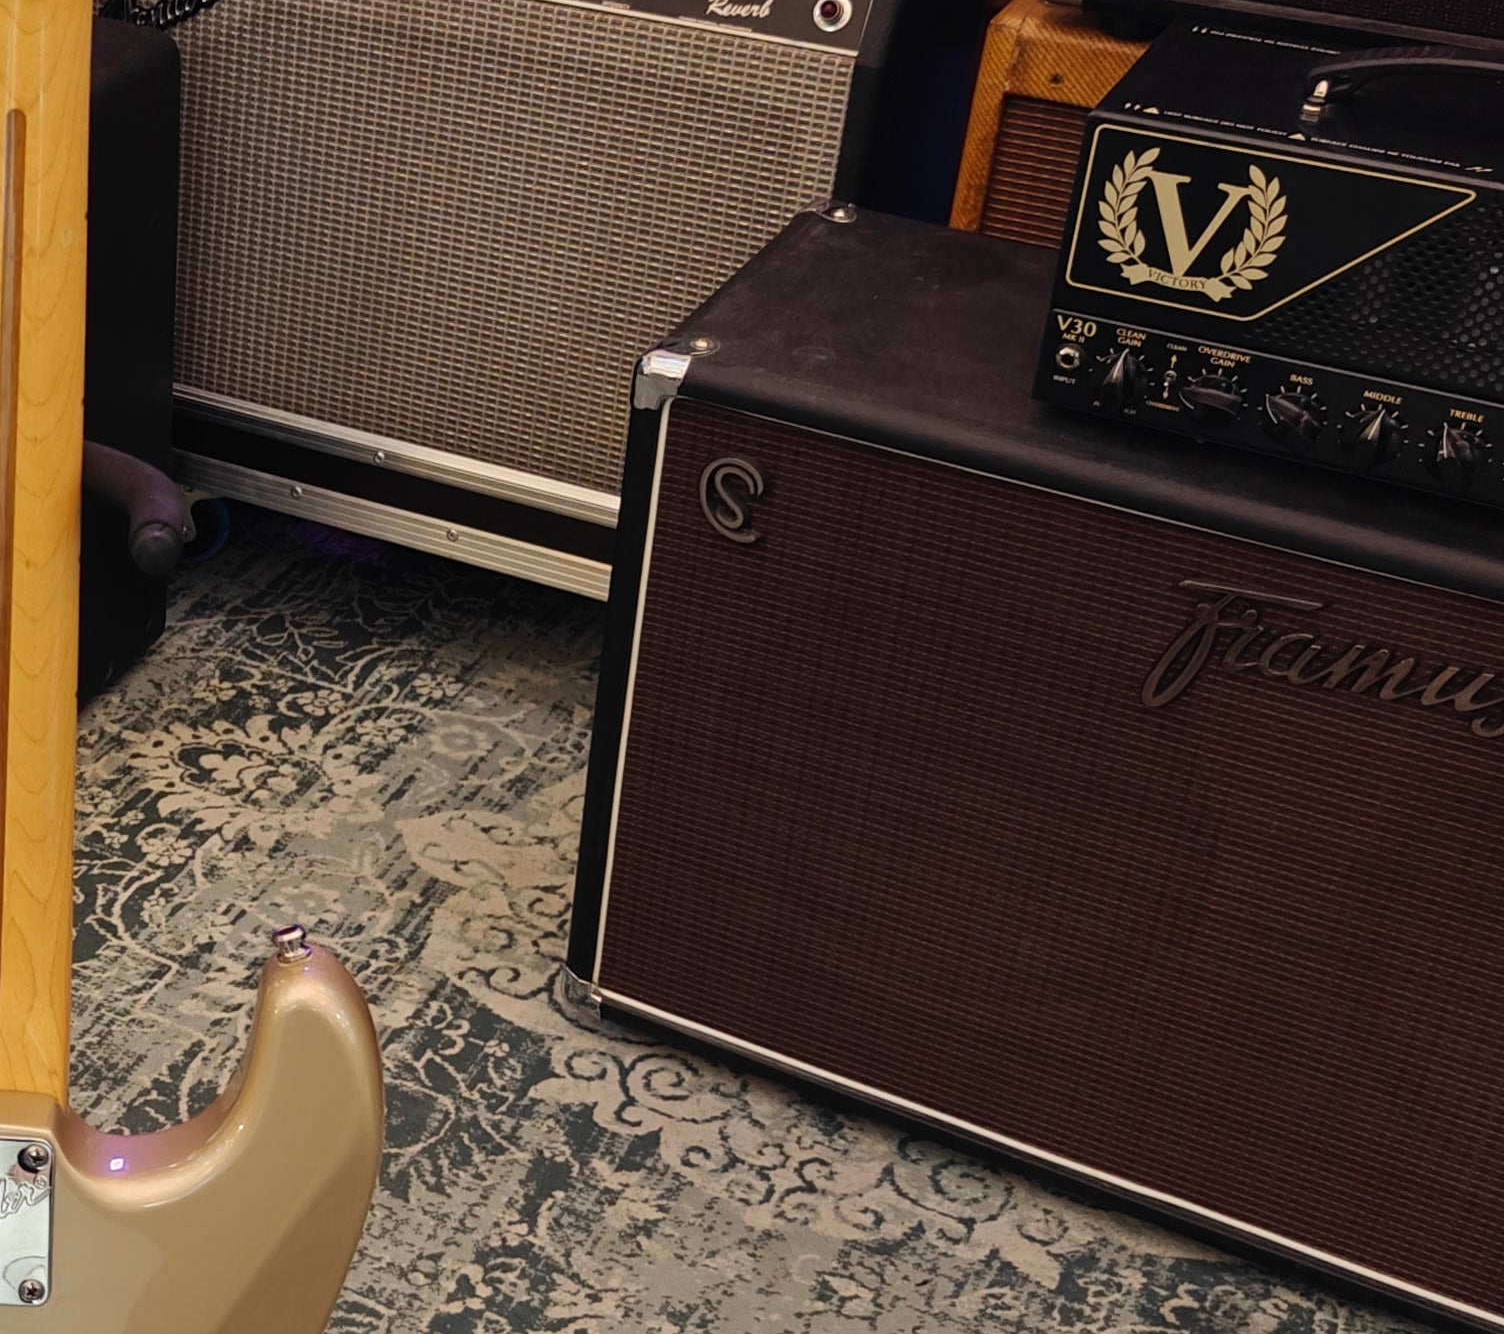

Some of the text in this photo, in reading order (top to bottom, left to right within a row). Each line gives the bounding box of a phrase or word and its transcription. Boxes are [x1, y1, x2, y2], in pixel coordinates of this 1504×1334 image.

[1148, 268, 1207, 289] VICTORY
[1057, 315, 1097, 338] V30
[1062, 333, 1075, 342] MK
[1116, 327, 1146, 341] CLEAN
[1117, 337, 1142, 348] GAIN
[1198, 345, 1252, 364] OVERDRIVE
[1210, 357, 1236, 368] GAIN
[1289, 373, 1314, 386] BASS
[1362, 390, 1403, 405] MIDDLE
[1449, 408, 1485, 423] TREBLE
